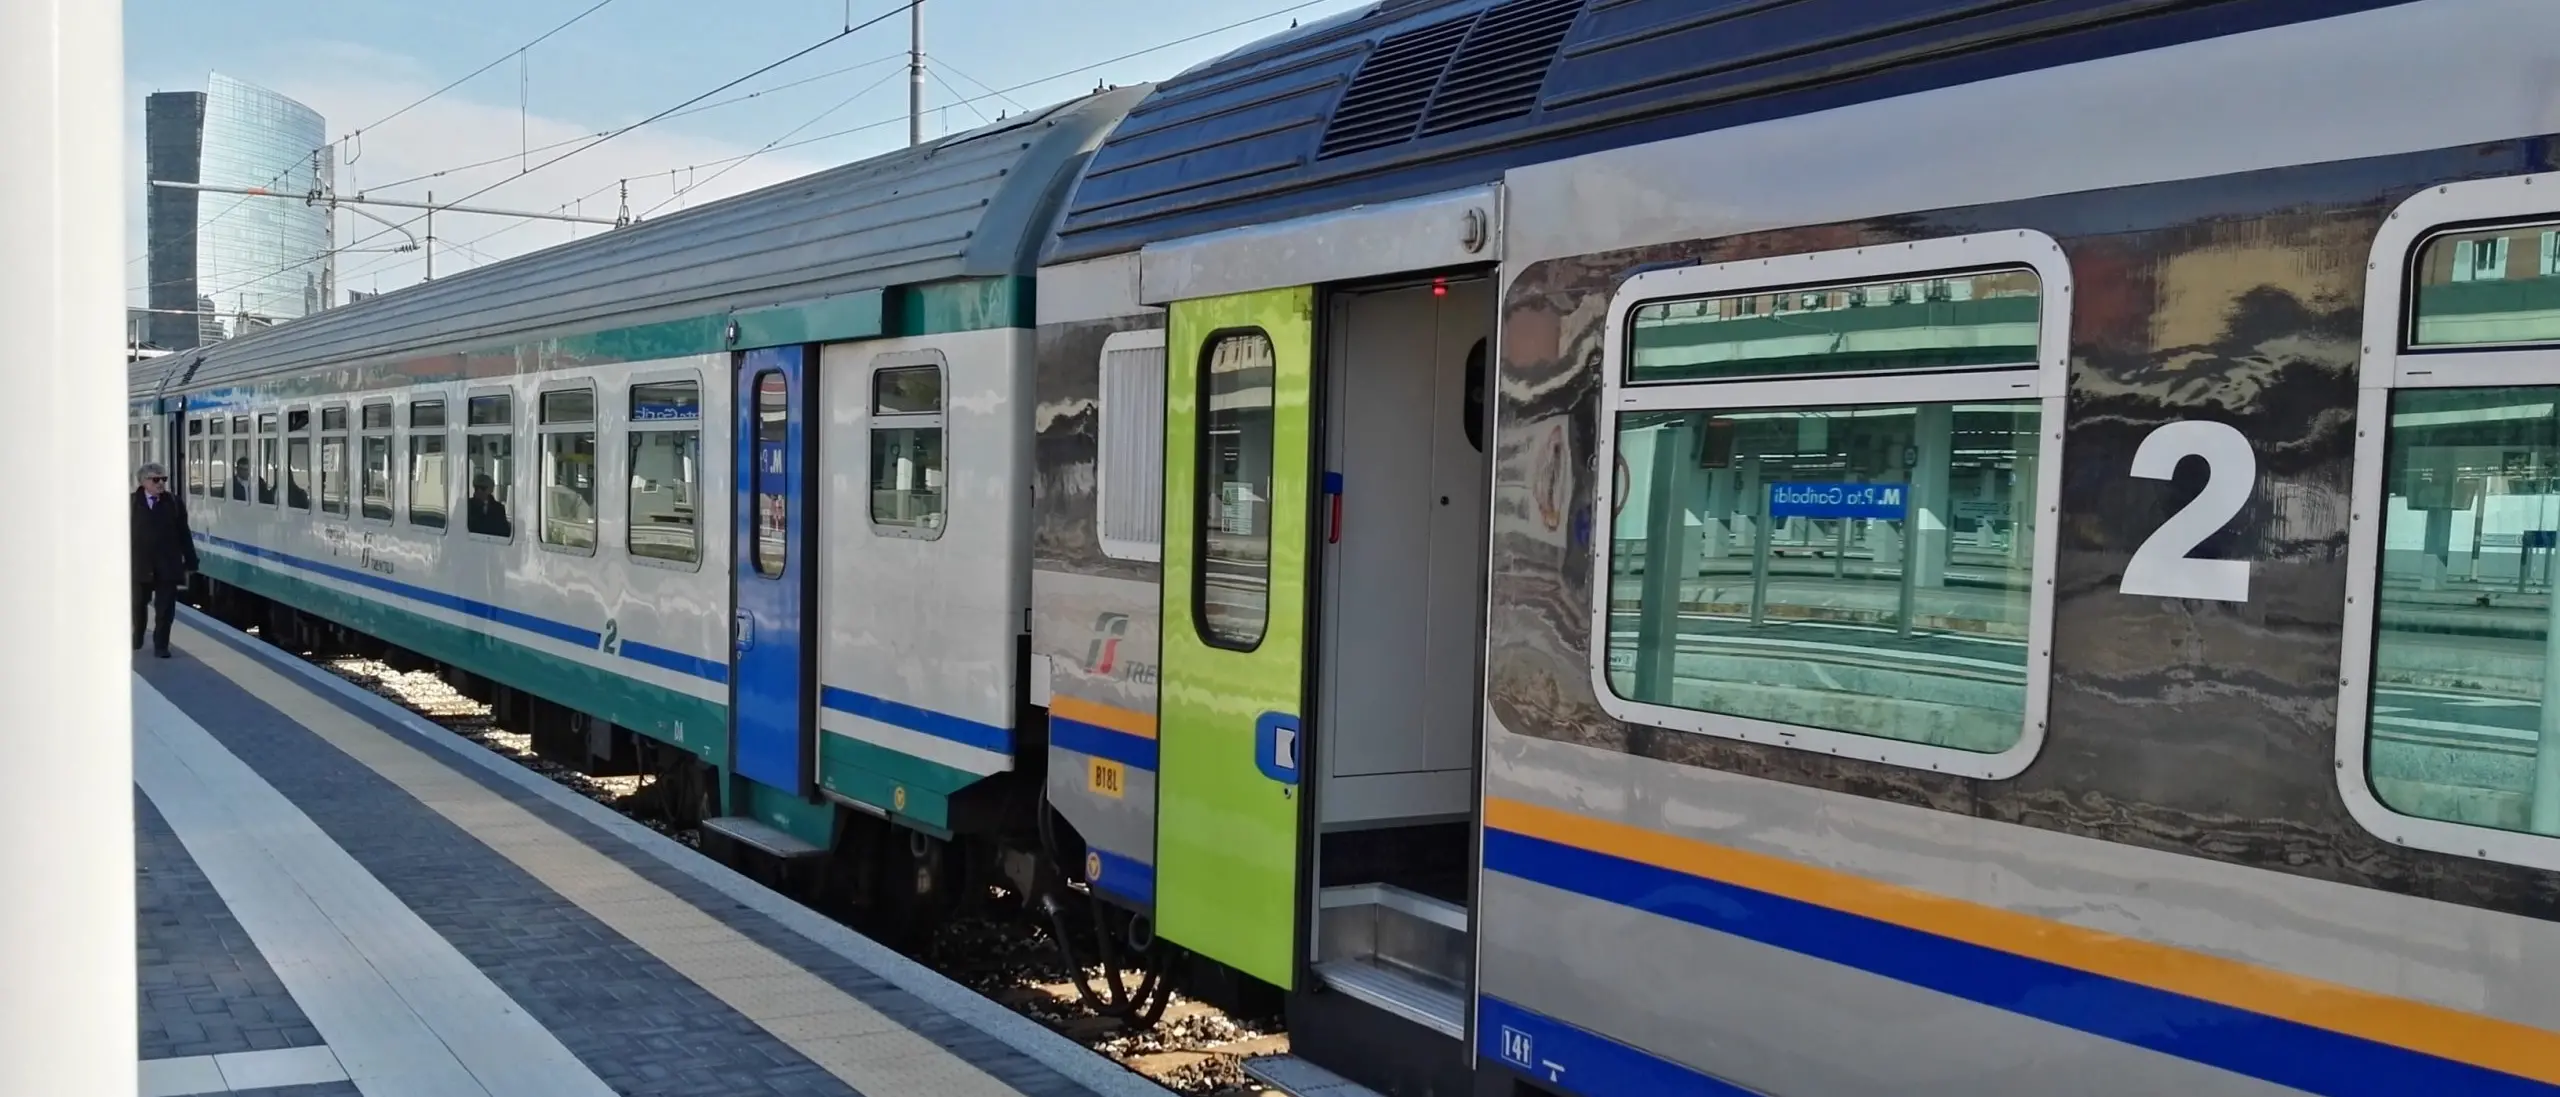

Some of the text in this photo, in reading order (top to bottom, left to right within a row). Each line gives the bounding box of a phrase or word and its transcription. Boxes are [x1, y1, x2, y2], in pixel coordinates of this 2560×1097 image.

[2119, 419, 2257, 603] 2
[603, 618, 617, 655] 2
[1125, 660, 1157, 685] TRE
